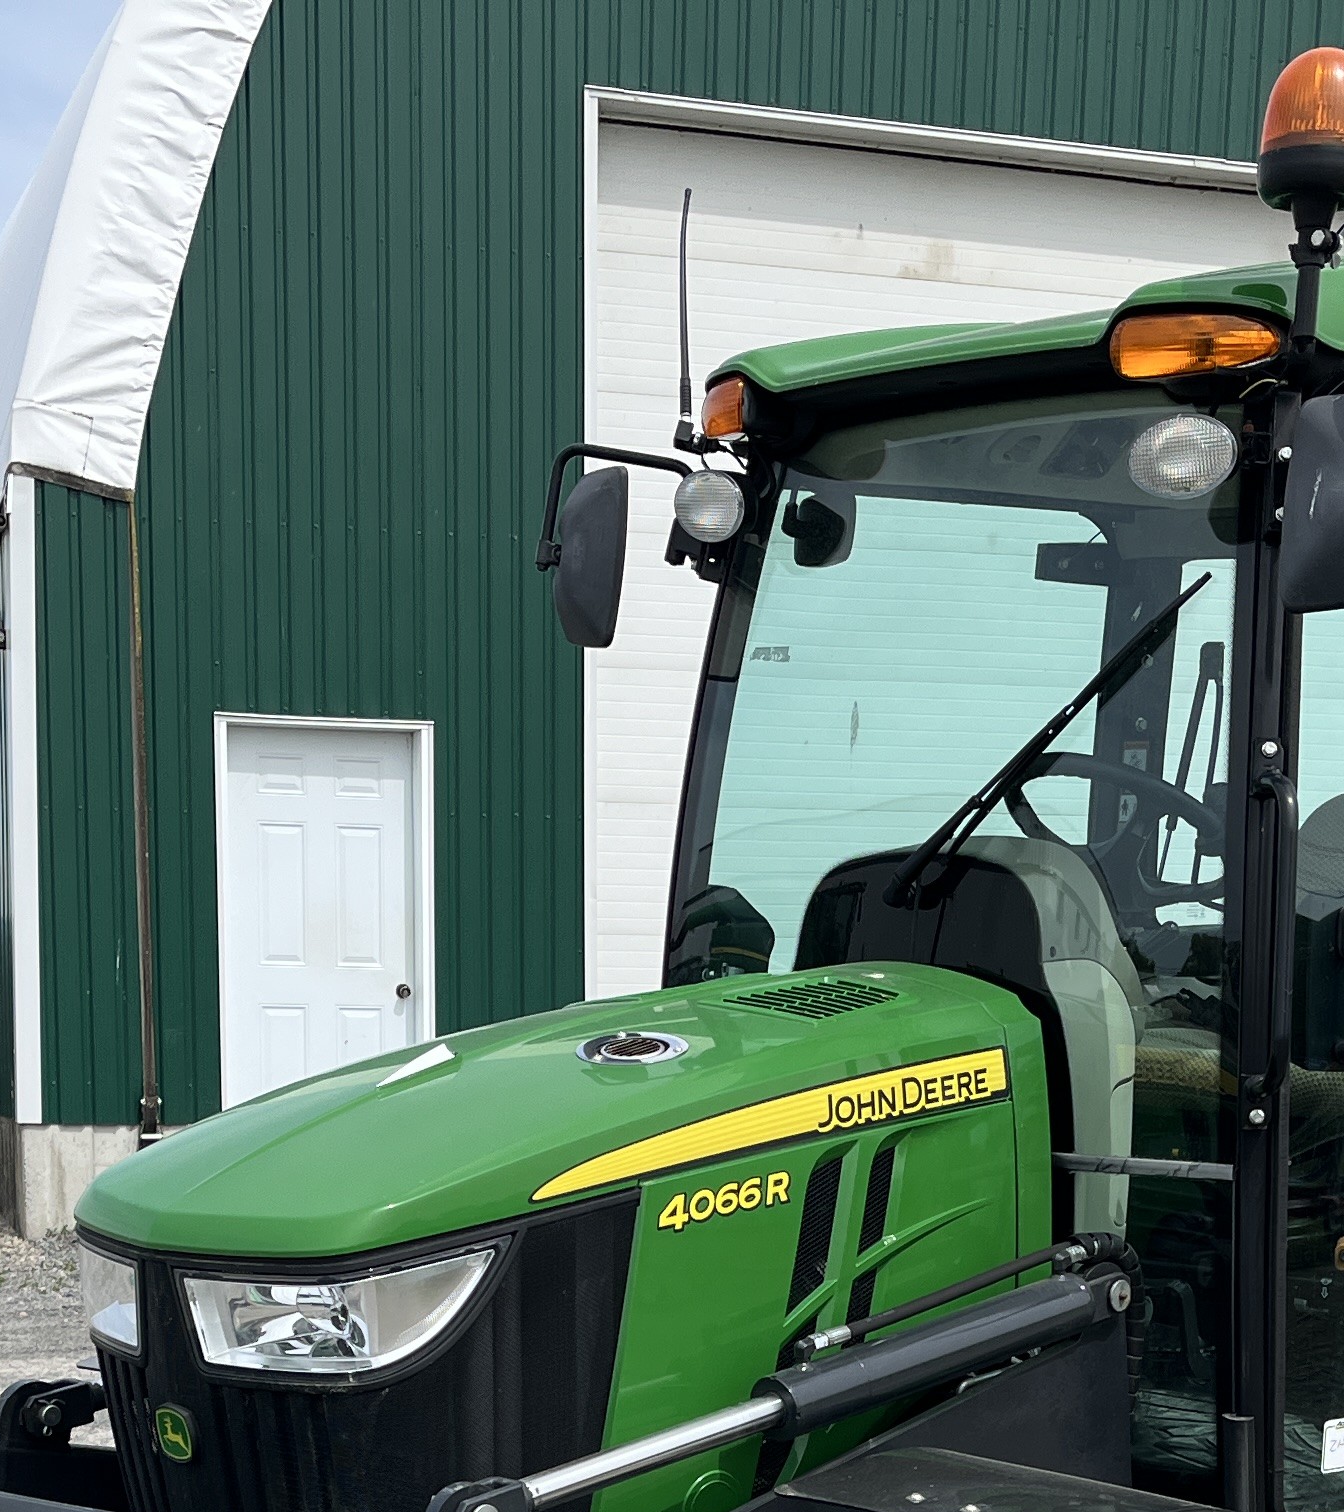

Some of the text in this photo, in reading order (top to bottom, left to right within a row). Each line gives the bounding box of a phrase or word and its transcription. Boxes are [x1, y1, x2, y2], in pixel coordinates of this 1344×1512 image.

[817, 1068, 989, 1128] JOHN DEERE
[657, 1170, 791, 1233] 4066R
